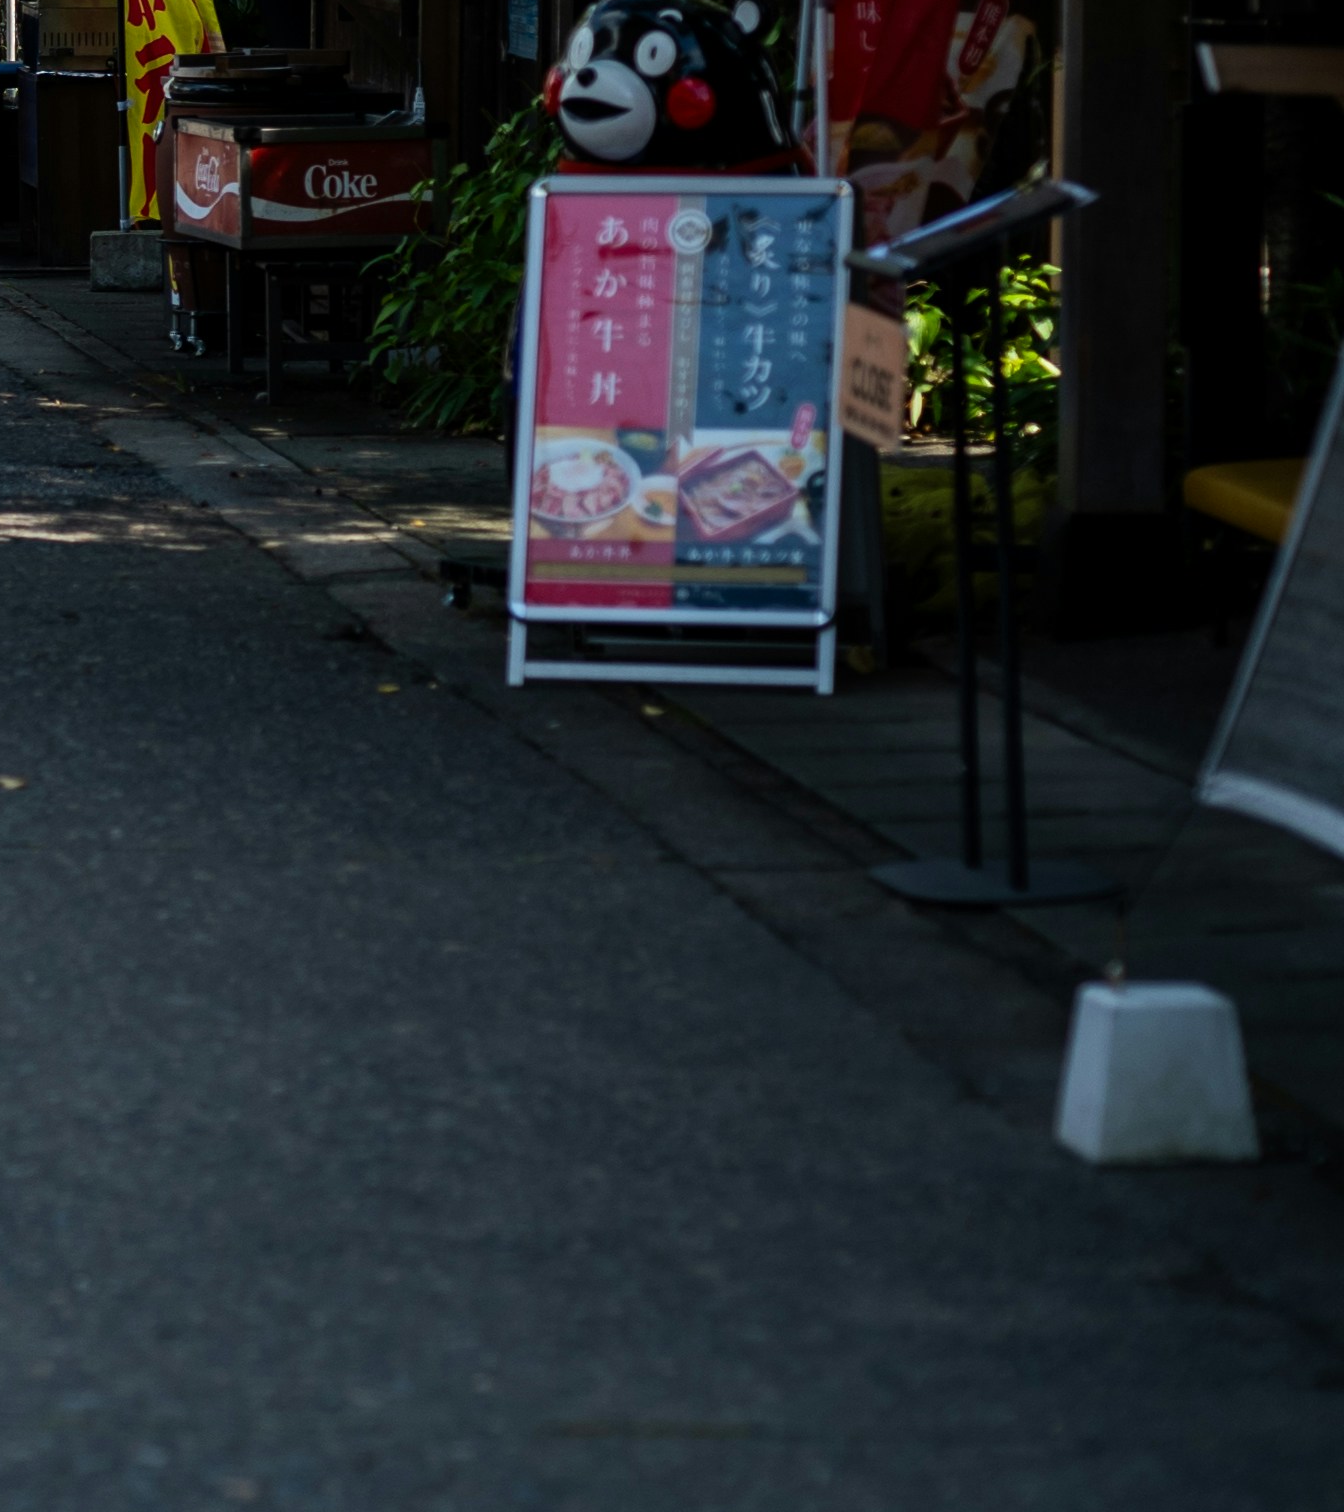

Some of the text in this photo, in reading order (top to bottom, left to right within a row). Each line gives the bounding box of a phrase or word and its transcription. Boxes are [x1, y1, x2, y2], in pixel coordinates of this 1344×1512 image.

[304, 164, 379, 200] Coke
[590, 216, 630, 406] あか牛丼
